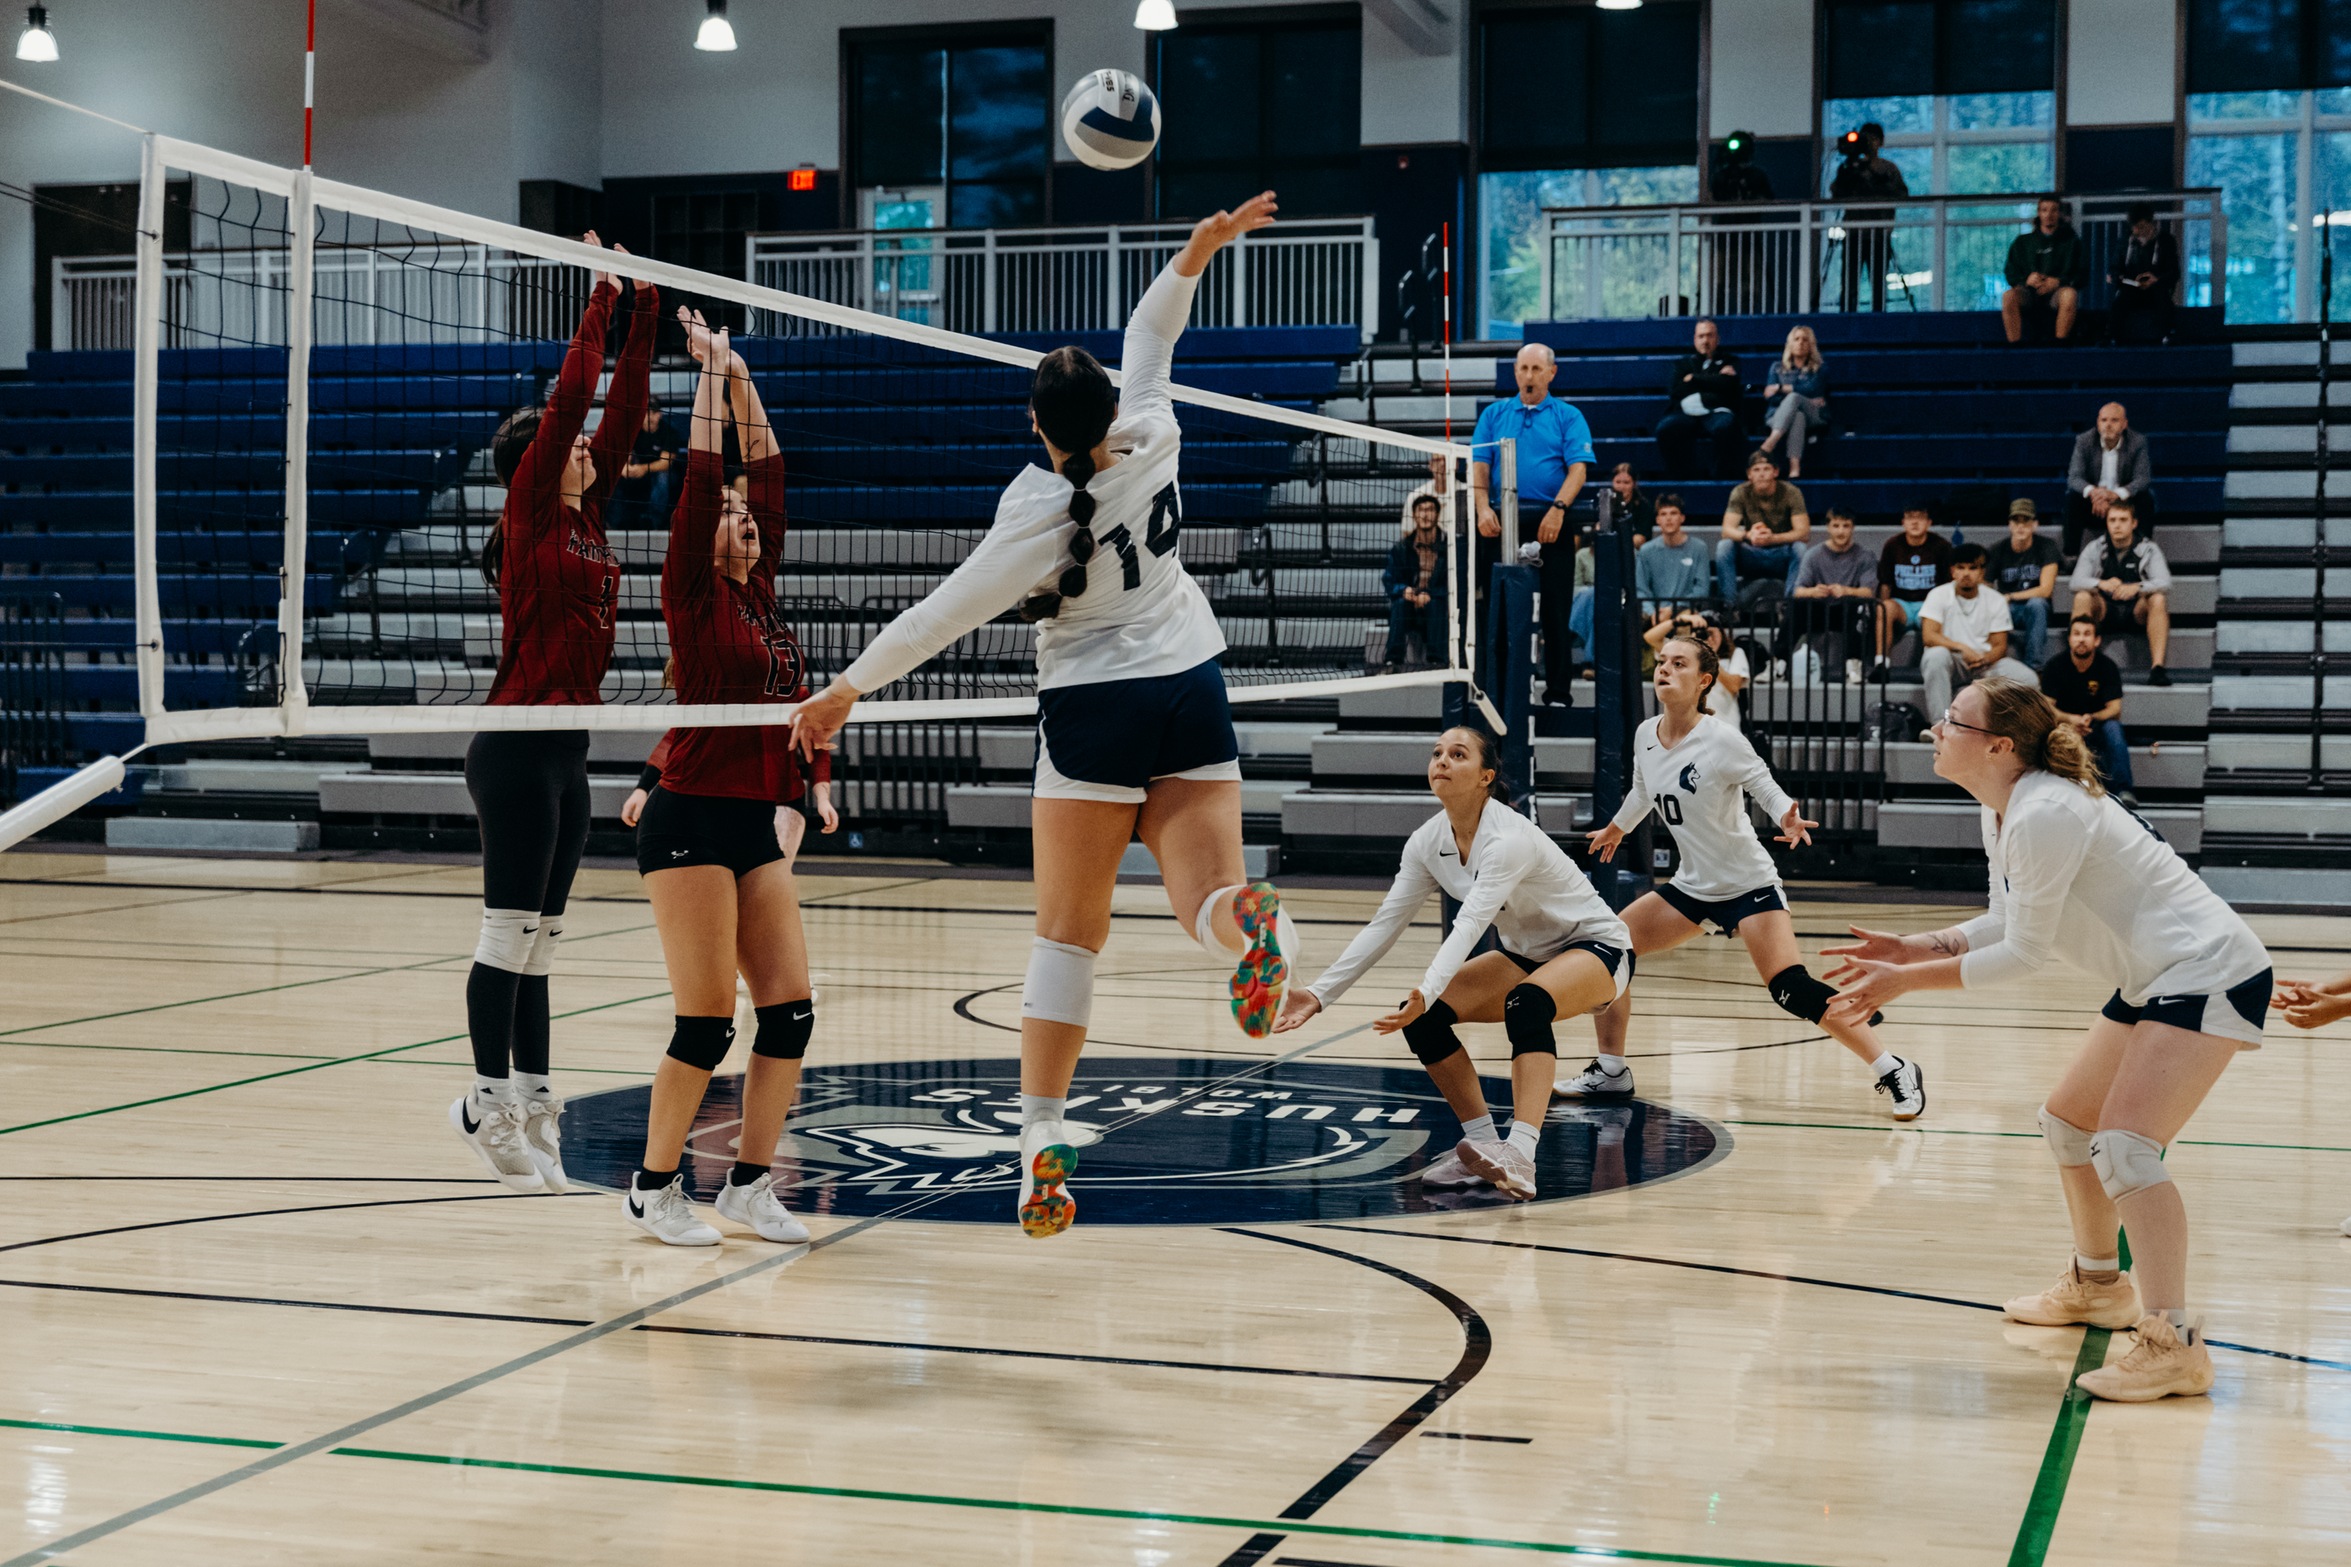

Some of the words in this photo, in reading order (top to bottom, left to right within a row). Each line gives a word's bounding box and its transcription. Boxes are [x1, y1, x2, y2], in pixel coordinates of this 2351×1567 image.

[1098, 480, 1181, 592] 14
[760, 636, 802, 697] 13
[1653, 793, 1684, 826] 10
[1102, 1084, 1293, 1100] WOLBI
